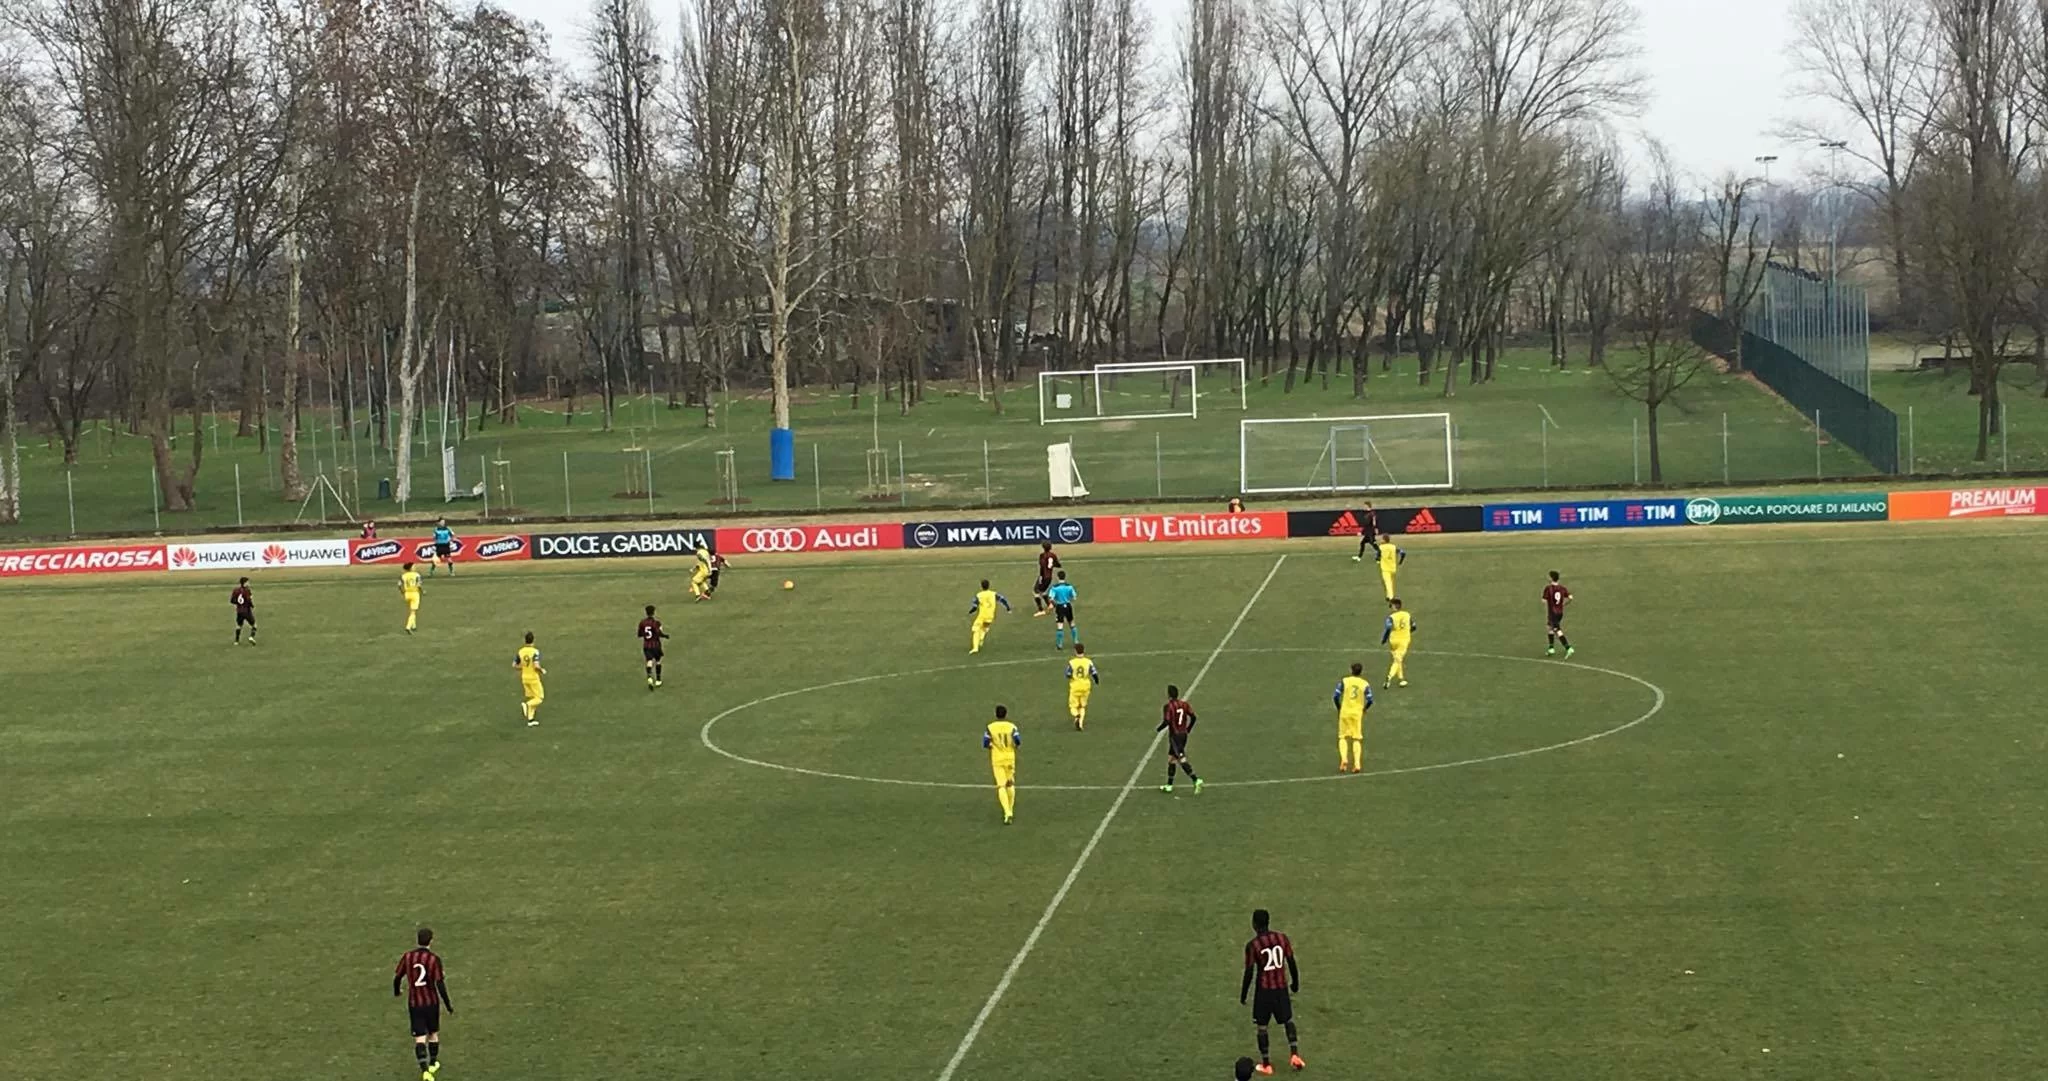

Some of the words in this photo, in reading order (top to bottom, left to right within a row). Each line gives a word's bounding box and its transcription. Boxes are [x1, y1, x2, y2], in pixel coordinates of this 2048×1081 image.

[1950, 490, 2036, 507] PREMIUM
[1577, 507, 1609, 522] TIM
[1644, 505, 1676, 520] TIM
[1723, 505, 1764, 516] BANCA
[1767, 503, 1822, 515] POPOLARE
[1826, 502, 1837, 513] DI
[1840, 501, 1887, 513] MILANO
[1511, 510, 1542, 525] TIM
[947, 526, 1003, 542] NIVEA
[1005, 525, 1050, 540] MEN
[1119, 517, 1157, 541] Fly
[1162, 514, 1262, 537] Emirates
[540, 535, 600, 555] DOLCE
[602, 543, 610, 553] &
[611, 533, 708, 553] GABBANA
[813, 527, 877, 548] Audi
[199, 551, 255, 562] HUAWEI
[289, 548, 346, 560] HUAWEI
[237, 592, 244, 605] 6
[1554, 591, 1561, 605] 9
[644, 626, 652, 639] 5
[523, 655, 530, 667] 9
[1076, 666, 1084, 679] 8
[1350, 685, 1359, 700] 3
[1176, 708, 1184, 725] 7
[1261, 945, 1284, 971] 20
[413, 963, 427, 987] 2
